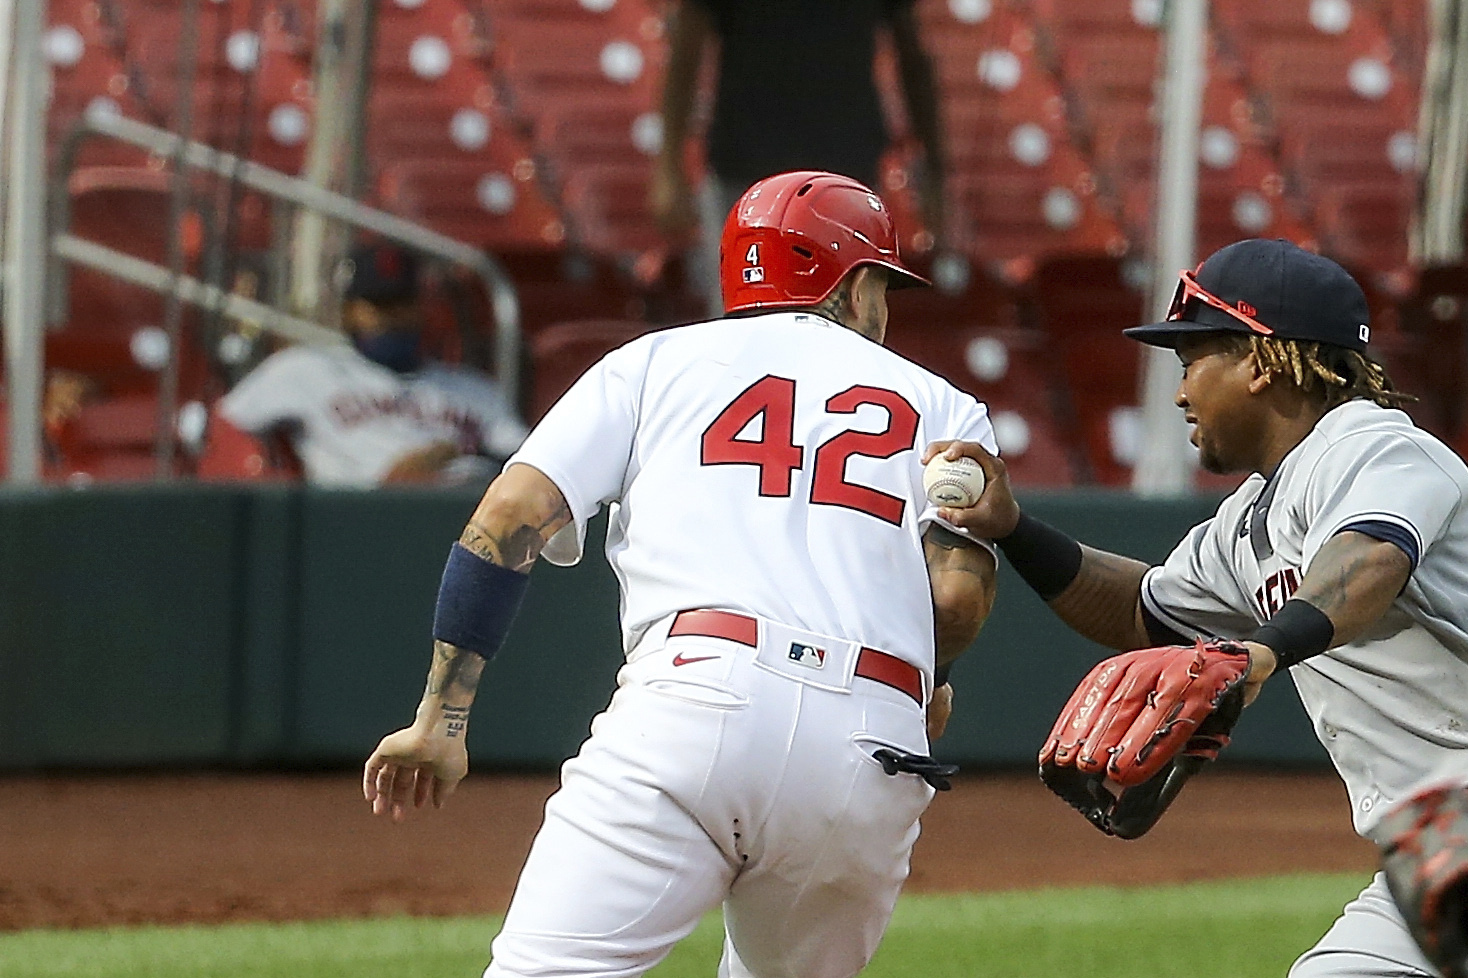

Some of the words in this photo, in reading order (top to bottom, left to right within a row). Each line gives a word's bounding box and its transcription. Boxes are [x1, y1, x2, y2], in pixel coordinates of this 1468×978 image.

[745, 243, 759, 266] 4
[701, 374, 920, 527] 42
[1072, 662, 1117, 730] EASTON
